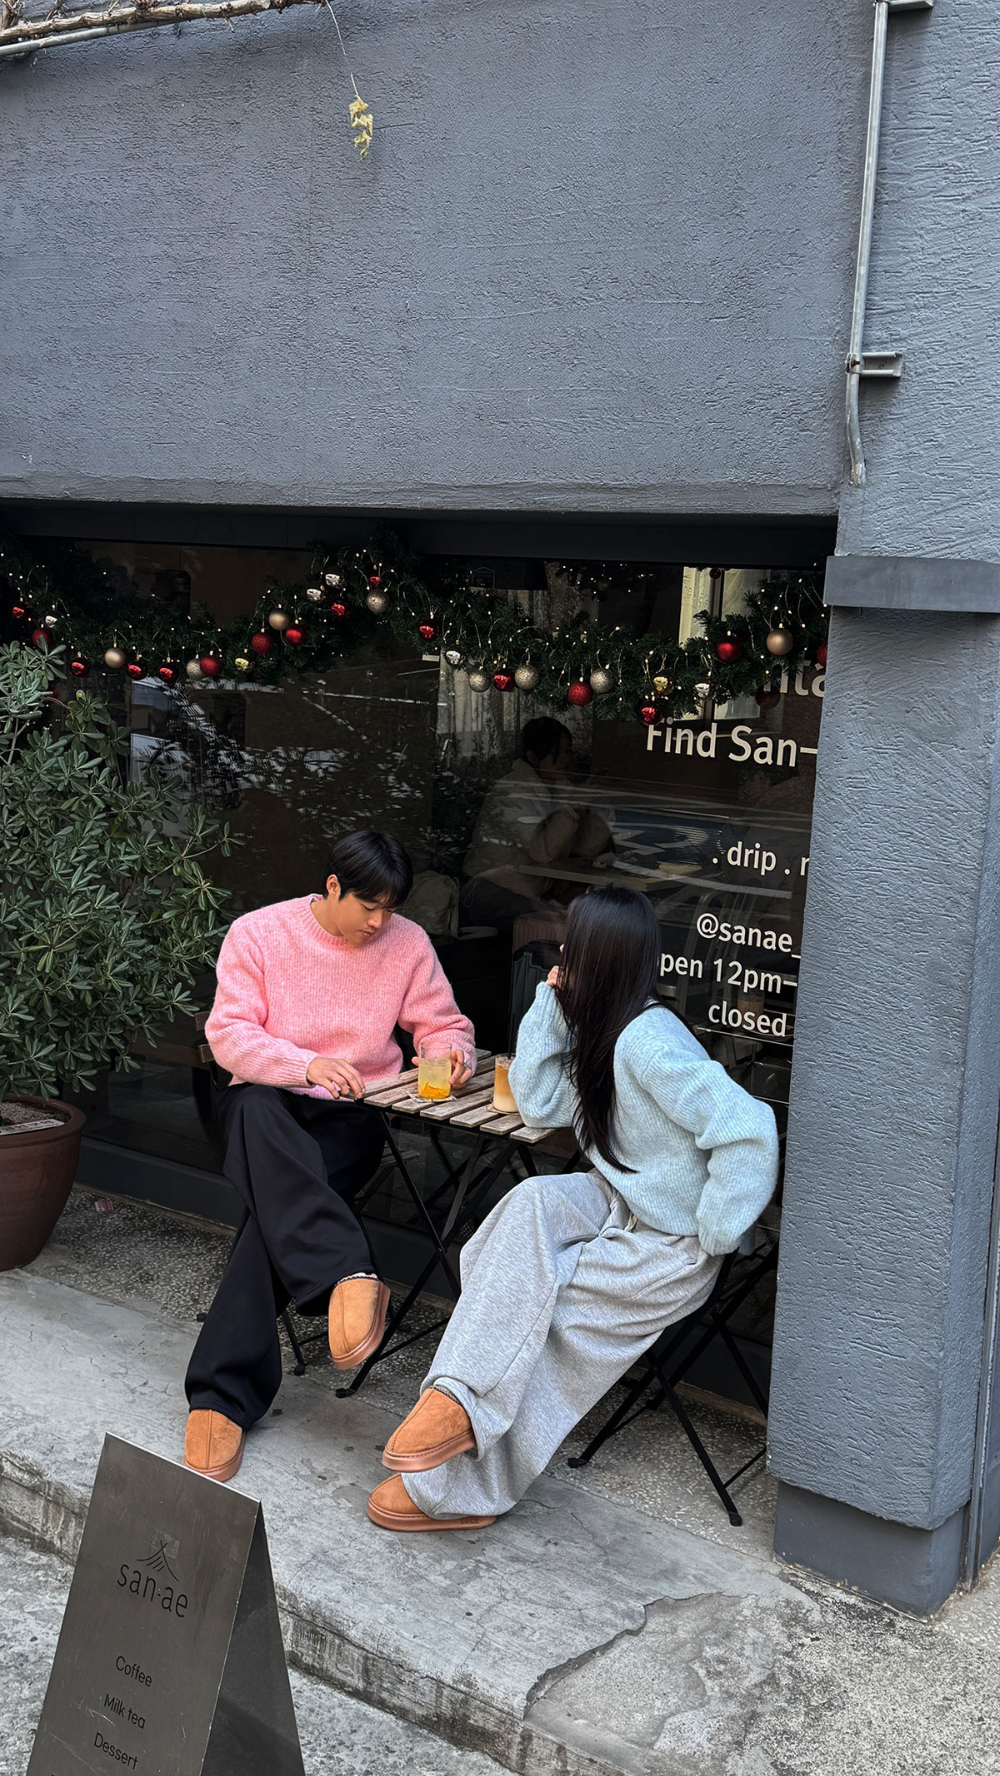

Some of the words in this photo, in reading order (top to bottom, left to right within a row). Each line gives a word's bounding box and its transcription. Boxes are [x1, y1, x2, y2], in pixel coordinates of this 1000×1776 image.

[646, 717, 718, 759] Find
[727, 841, 777, 876] drip
[660, 953, 703, 979] pen
[708, 1001, 787, 1037] closed
[116, 1656, 152, 1687] Coffee
[104, 1693, 126, 1718] Milk
[127, 1707, 146, 1730] tea
[94, 1732, 138, 1770] Dessert
